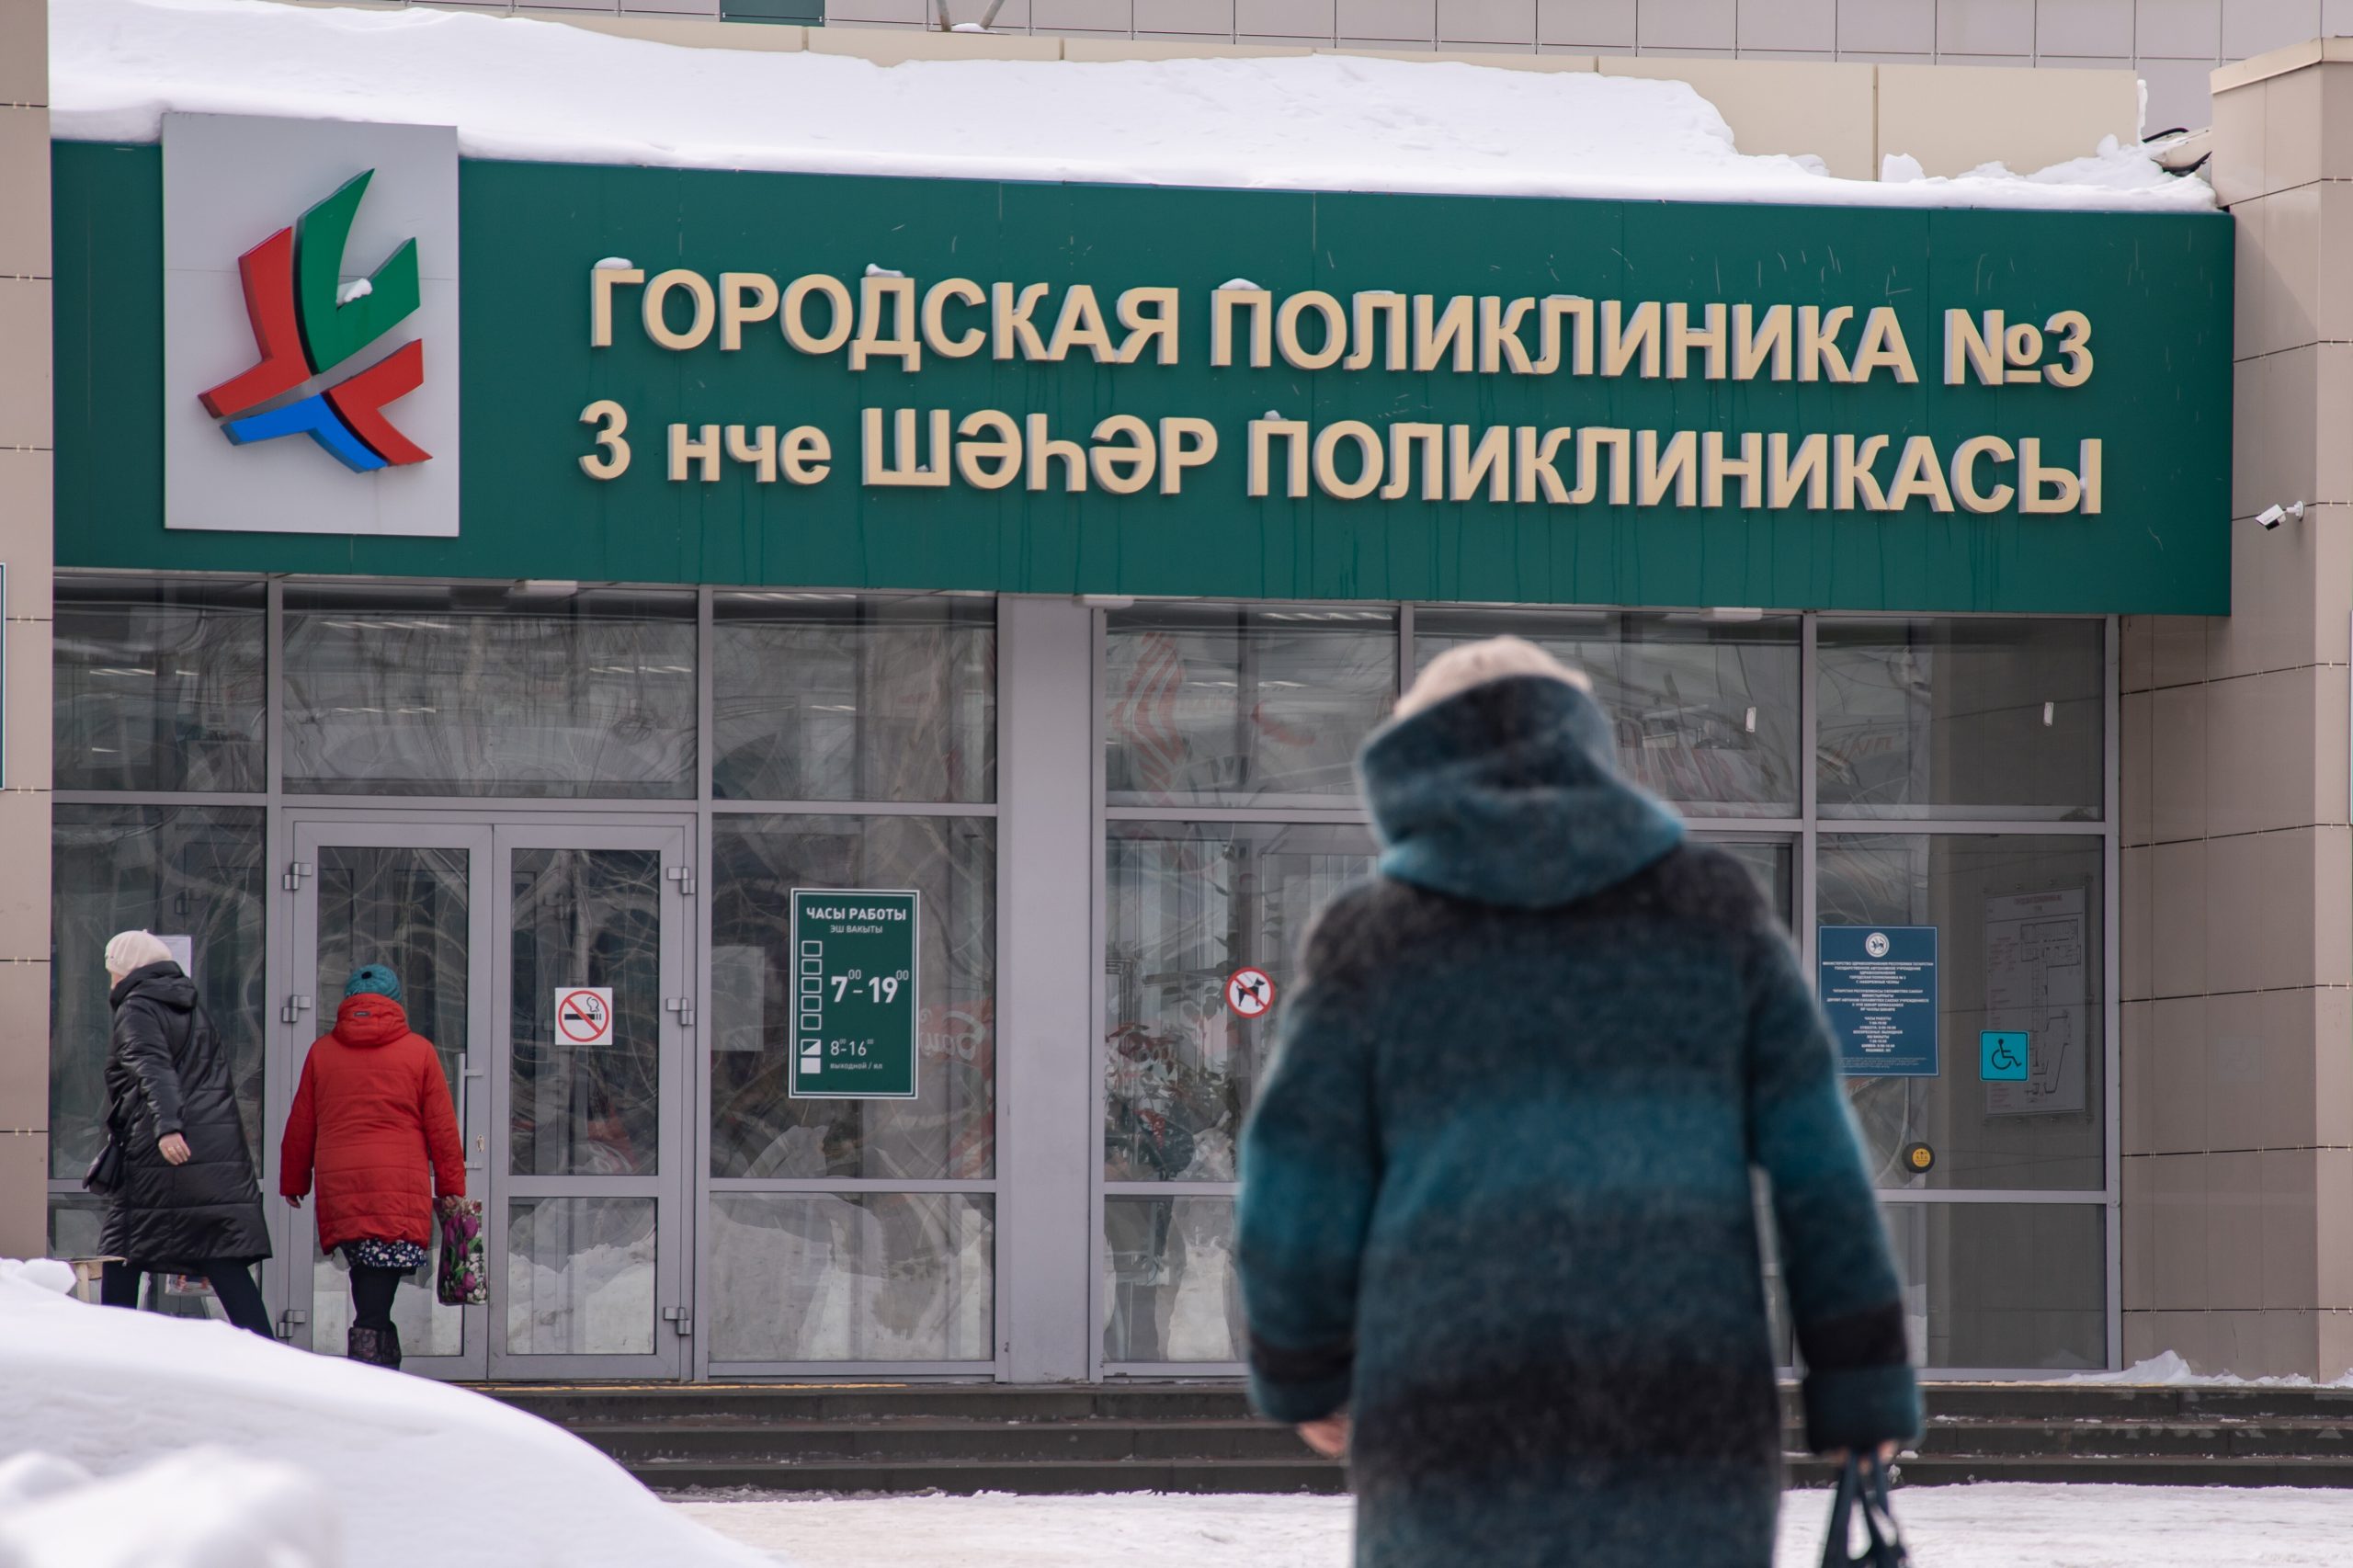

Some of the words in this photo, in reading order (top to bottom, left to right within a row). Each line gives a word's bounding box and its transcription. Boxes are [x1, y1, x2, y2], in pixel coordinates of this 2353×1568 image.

[592, 267, 1179, 372] ГОРОДСКАЯ
[1211, 288, 1918, 383] ПОЛИКЛИНИКА
[1944, 308, 2094, 388] №3
[579, 400, 631, 480] 3
[667, 424, 832, 485] нче
[1247, 419, 2102, 514] ПОЛИКЛИНИКАСЫ
[806, 907, 846, 919] ЧАСЫ
[849, 908, 906, 920] РАБОТЫ
[830, 925, 845, 933] ЭШ
[847, 925, 883, 933] ВАКЫТЫ
